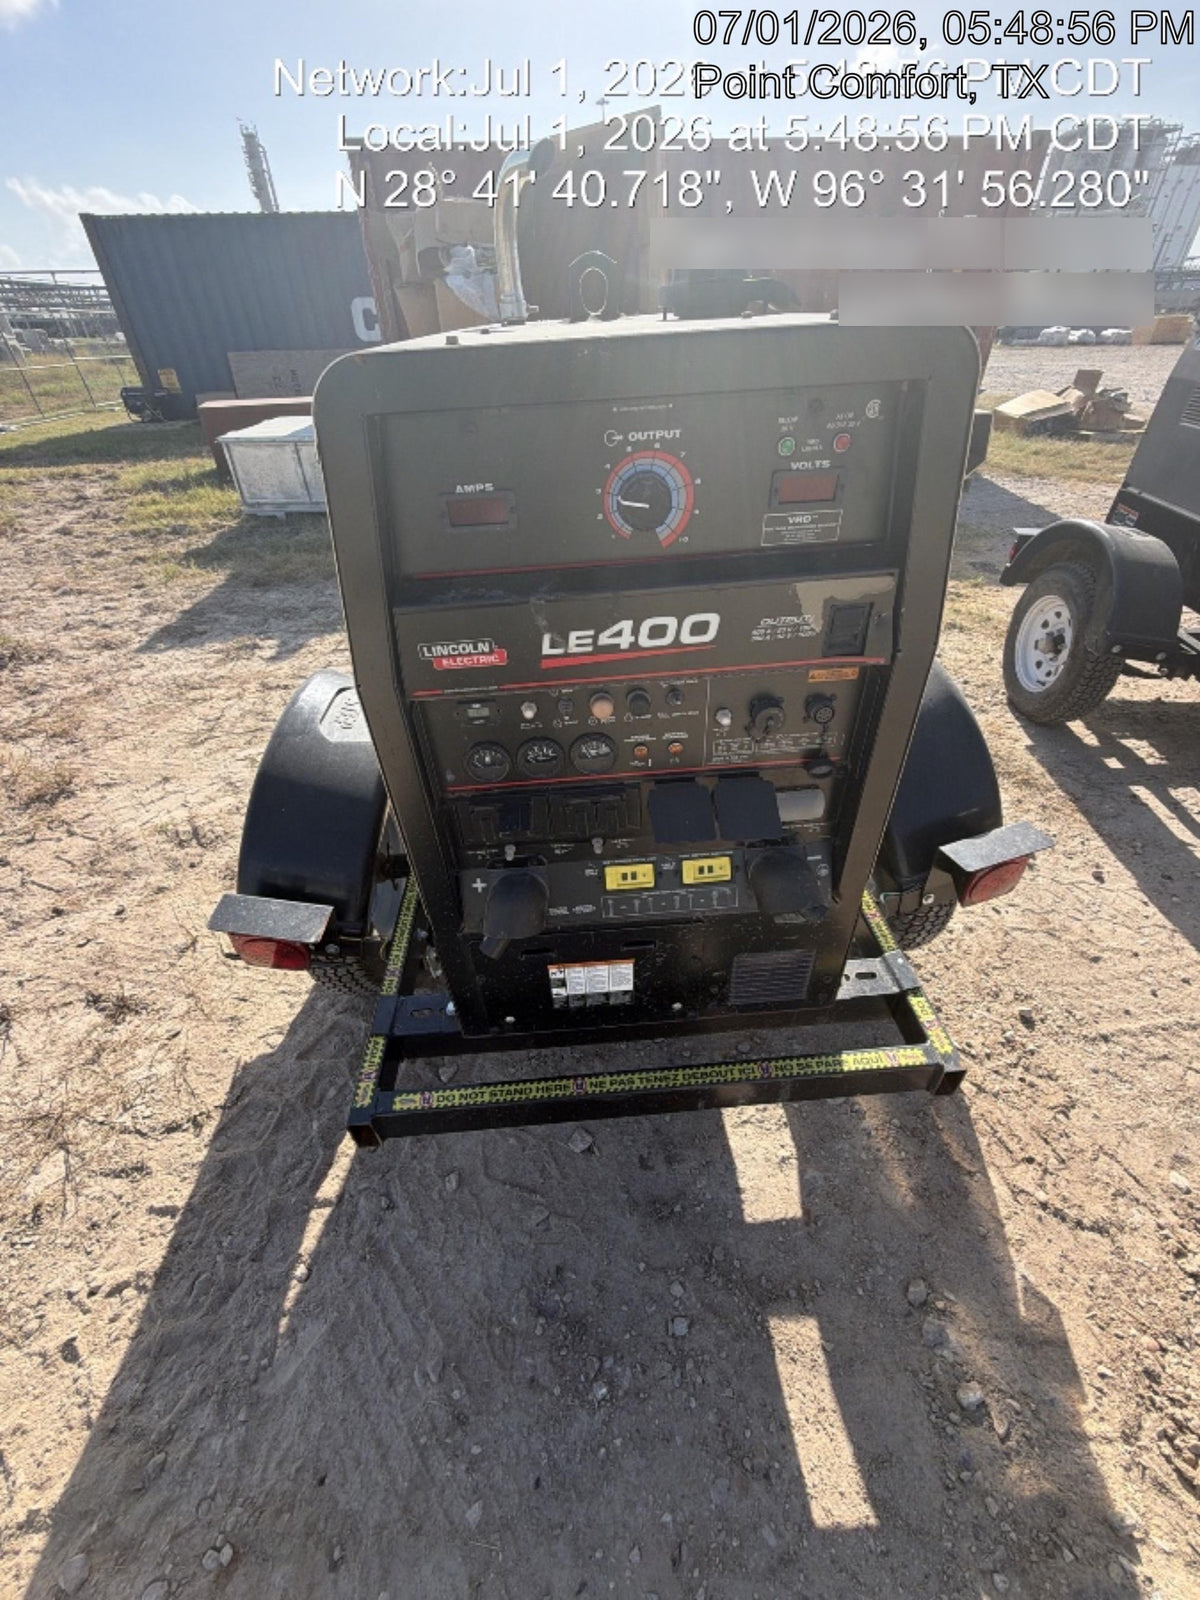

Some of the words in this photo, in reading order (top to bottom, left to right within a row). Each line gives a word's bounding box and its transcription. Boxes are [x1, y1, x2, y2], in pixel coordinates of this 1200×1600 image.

[628, 429, 682, 442] OUTPUT
[456, 482, 495, 493] AMPS
[540, 612, 721, 656] LE400
[422, 640, 490, 658] LINCOLN
[441, 653, 500, 667] ELECTRIC
[436, 1093, 456, 1103] DO
[459, 1090, 487, 1101] NOT
[489, 1086, 533, 1099] STAND
[536, 1083, 571, 1094] HERE
